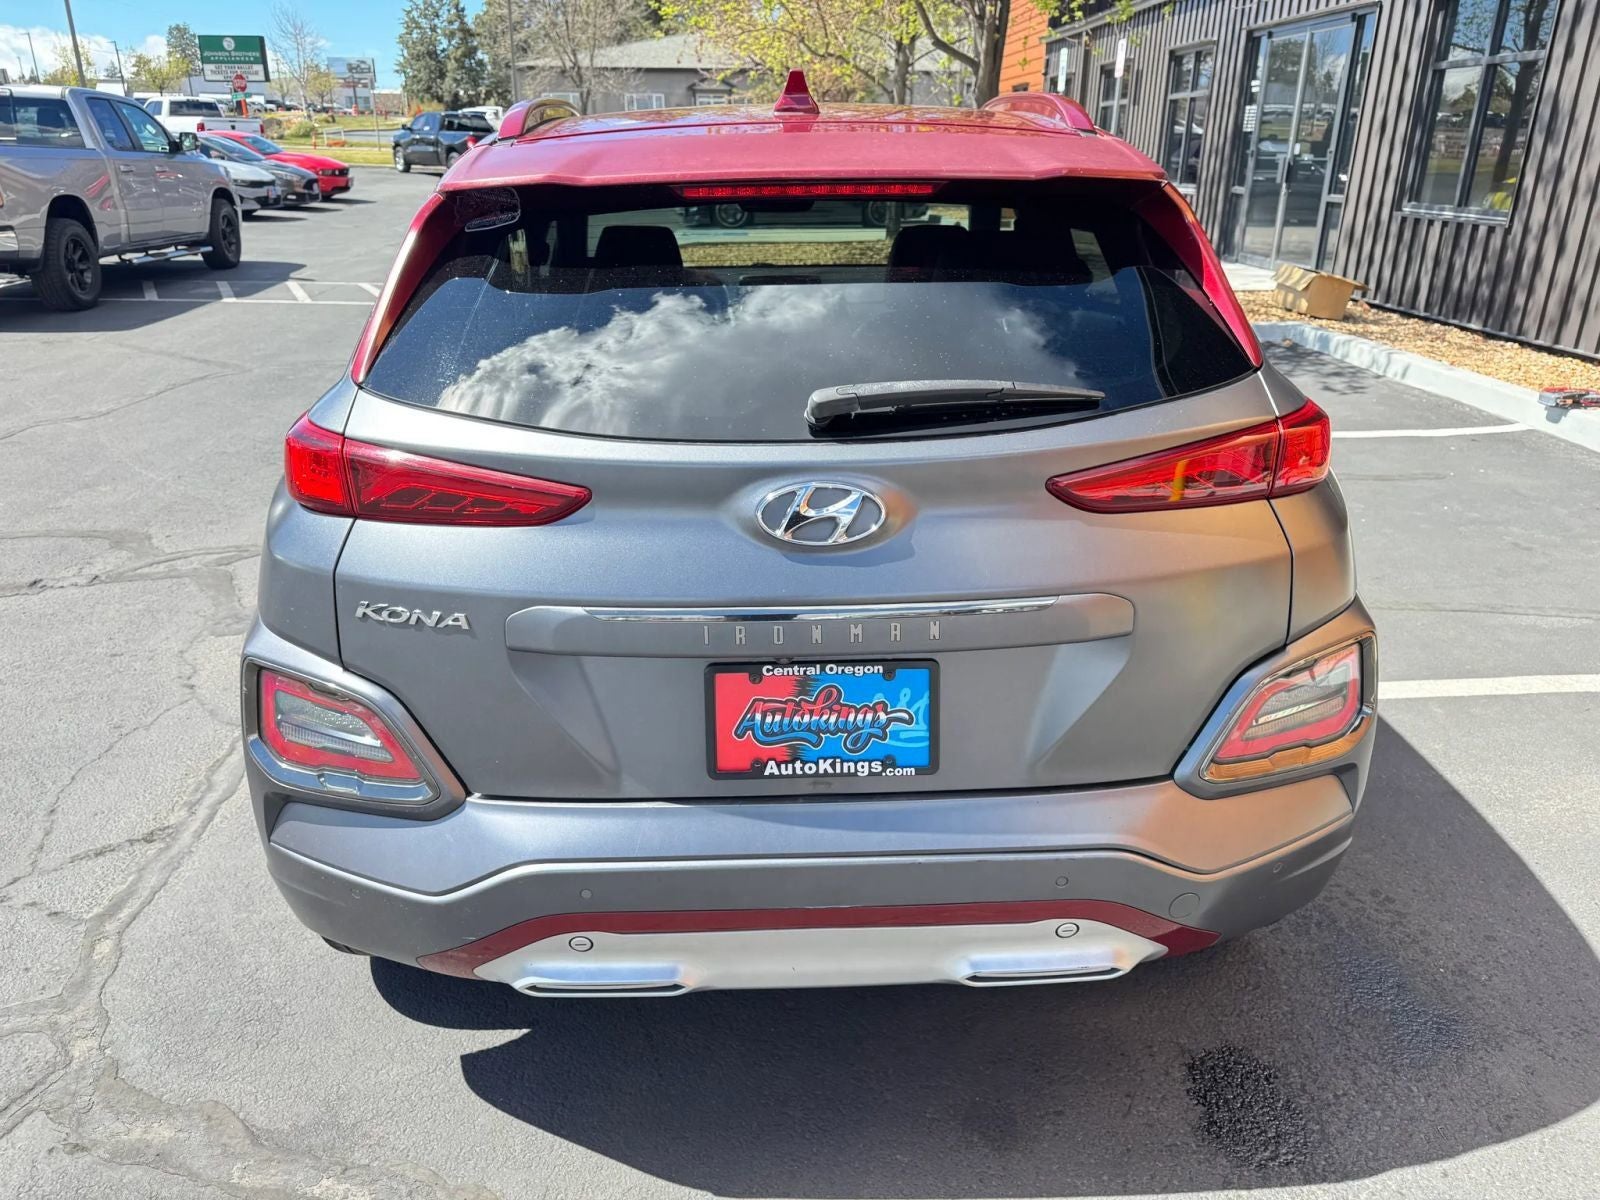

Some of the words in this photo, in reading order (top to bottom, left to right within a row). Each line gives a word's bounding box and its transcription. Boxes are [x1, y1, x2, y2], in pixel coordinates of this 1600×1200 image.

[355, 600, 471, 630] KONA
[703, 620, 941, 646] IRONMAN
[762, 664, 820, 677] Central
[825, 664, 883, 677] Oregon
[763, 757, 916, 777] AutoKings.com
